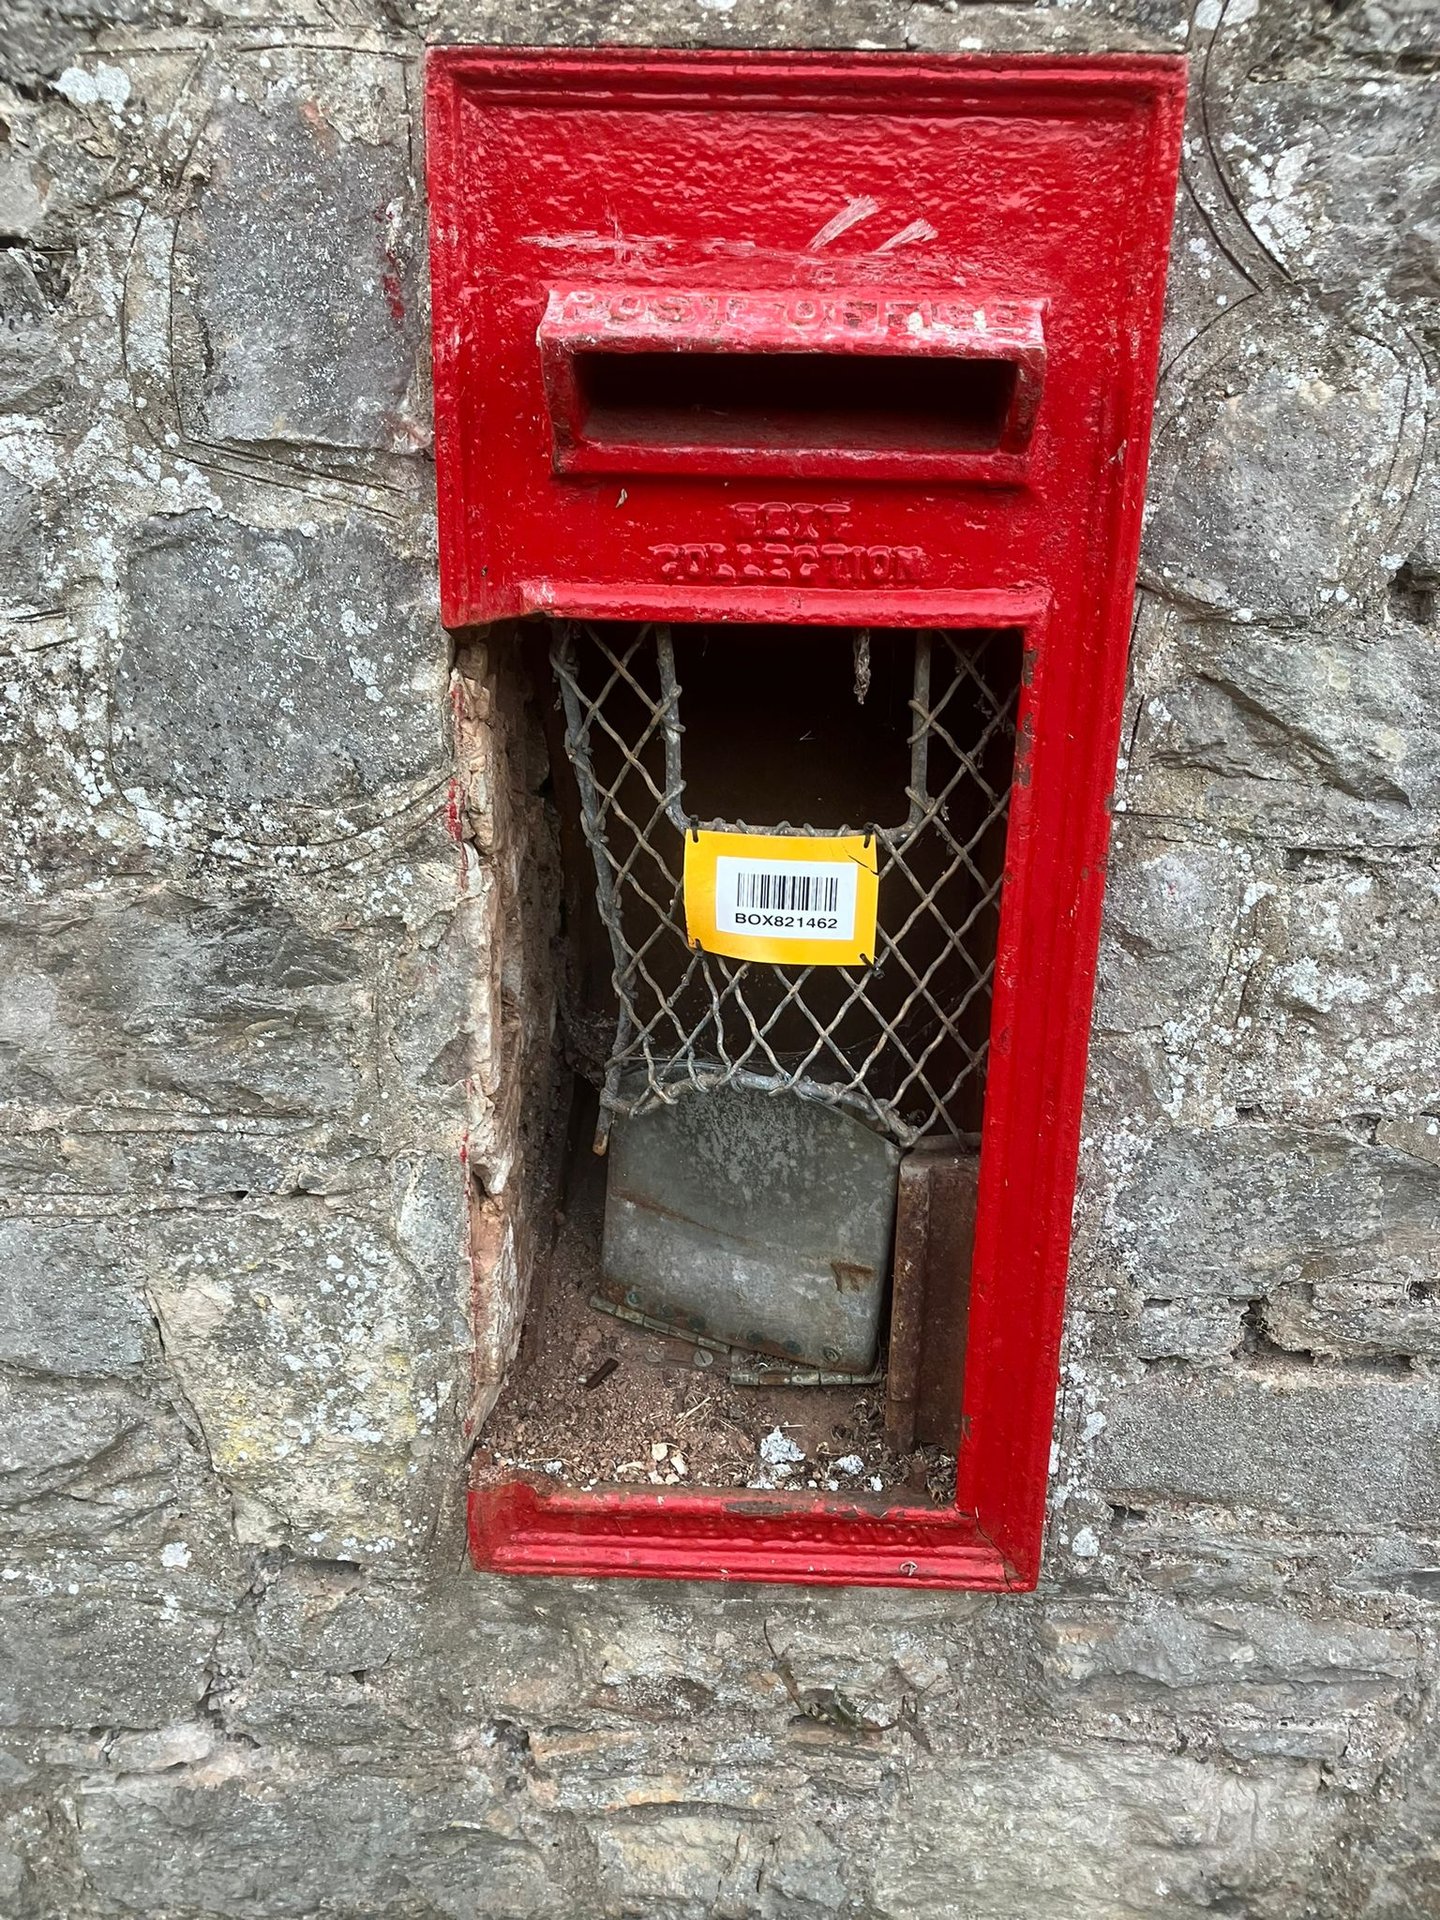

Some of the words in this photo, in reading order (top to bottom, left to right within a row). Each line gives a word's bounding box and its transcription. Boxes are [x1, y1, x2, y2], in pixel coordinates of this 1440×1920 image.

[564, 291, 747, 326] POST
[783, 296, 1034, 333] OFFICE
[731, 502, 851, 540] NEXT
[648, 543, 923, 580] COLLECTION
[735, 912, 838, 929] BOX821462
